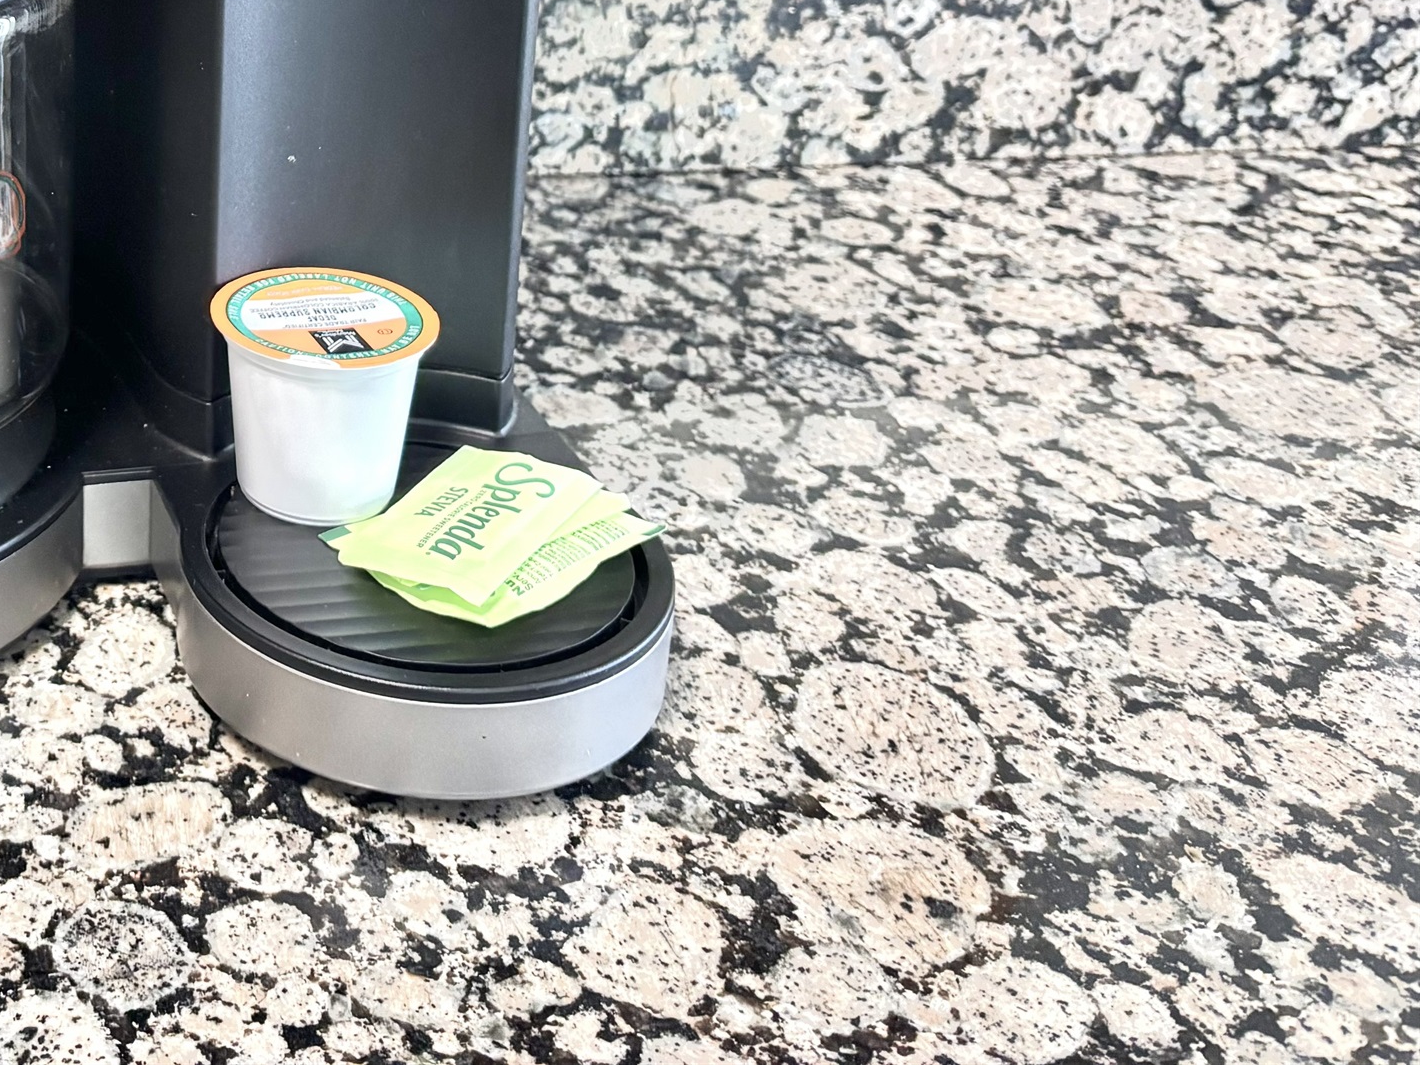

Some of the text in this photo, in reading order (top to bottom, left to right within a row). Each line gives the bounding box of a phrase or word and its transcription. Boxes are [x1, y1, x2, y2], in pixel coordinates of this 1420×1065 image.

[334, 275, 356, 285] NOT
[360, 281, 386, 294] UNIT
[313, 302, 376, 315] COLOMBIAN
[308, 314, 337, 322] DECAF
[414, 486, 469, 516] STEVIA
